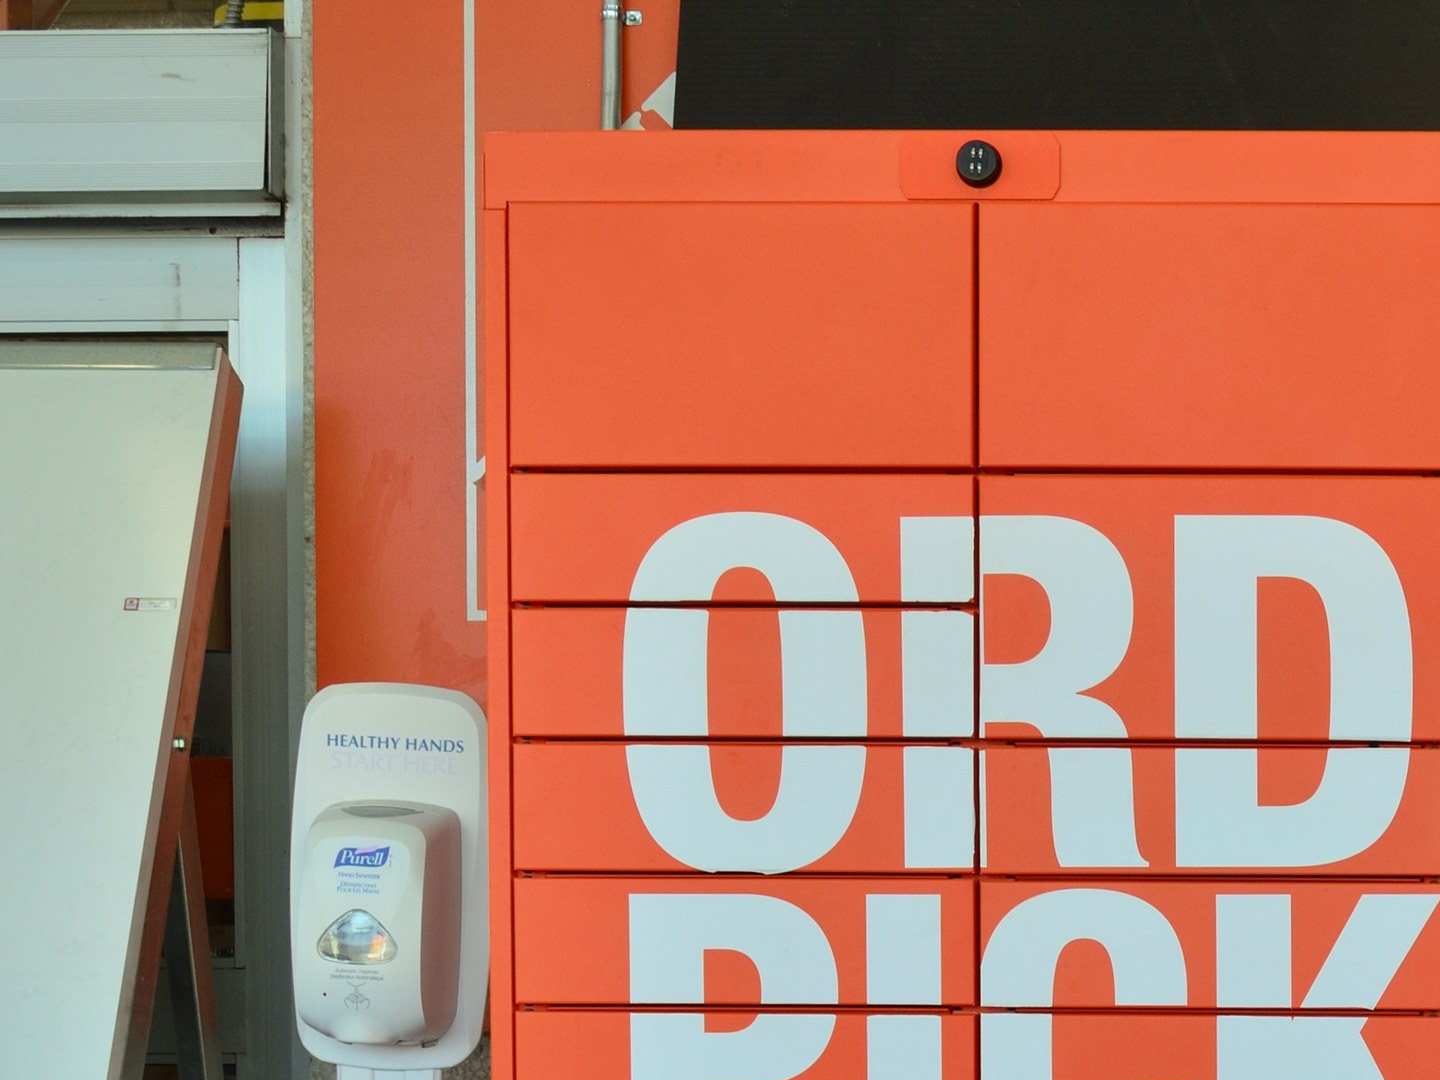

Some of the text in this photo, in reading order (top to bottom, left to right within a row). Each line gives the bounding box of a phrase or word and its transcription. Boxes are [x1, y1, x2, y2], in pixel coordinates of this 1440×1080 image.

[327, 734, 465, 754] HEALTHY HANDS
[331, 751, 394, 771] START
[340, 850, 384, 866] Purell
